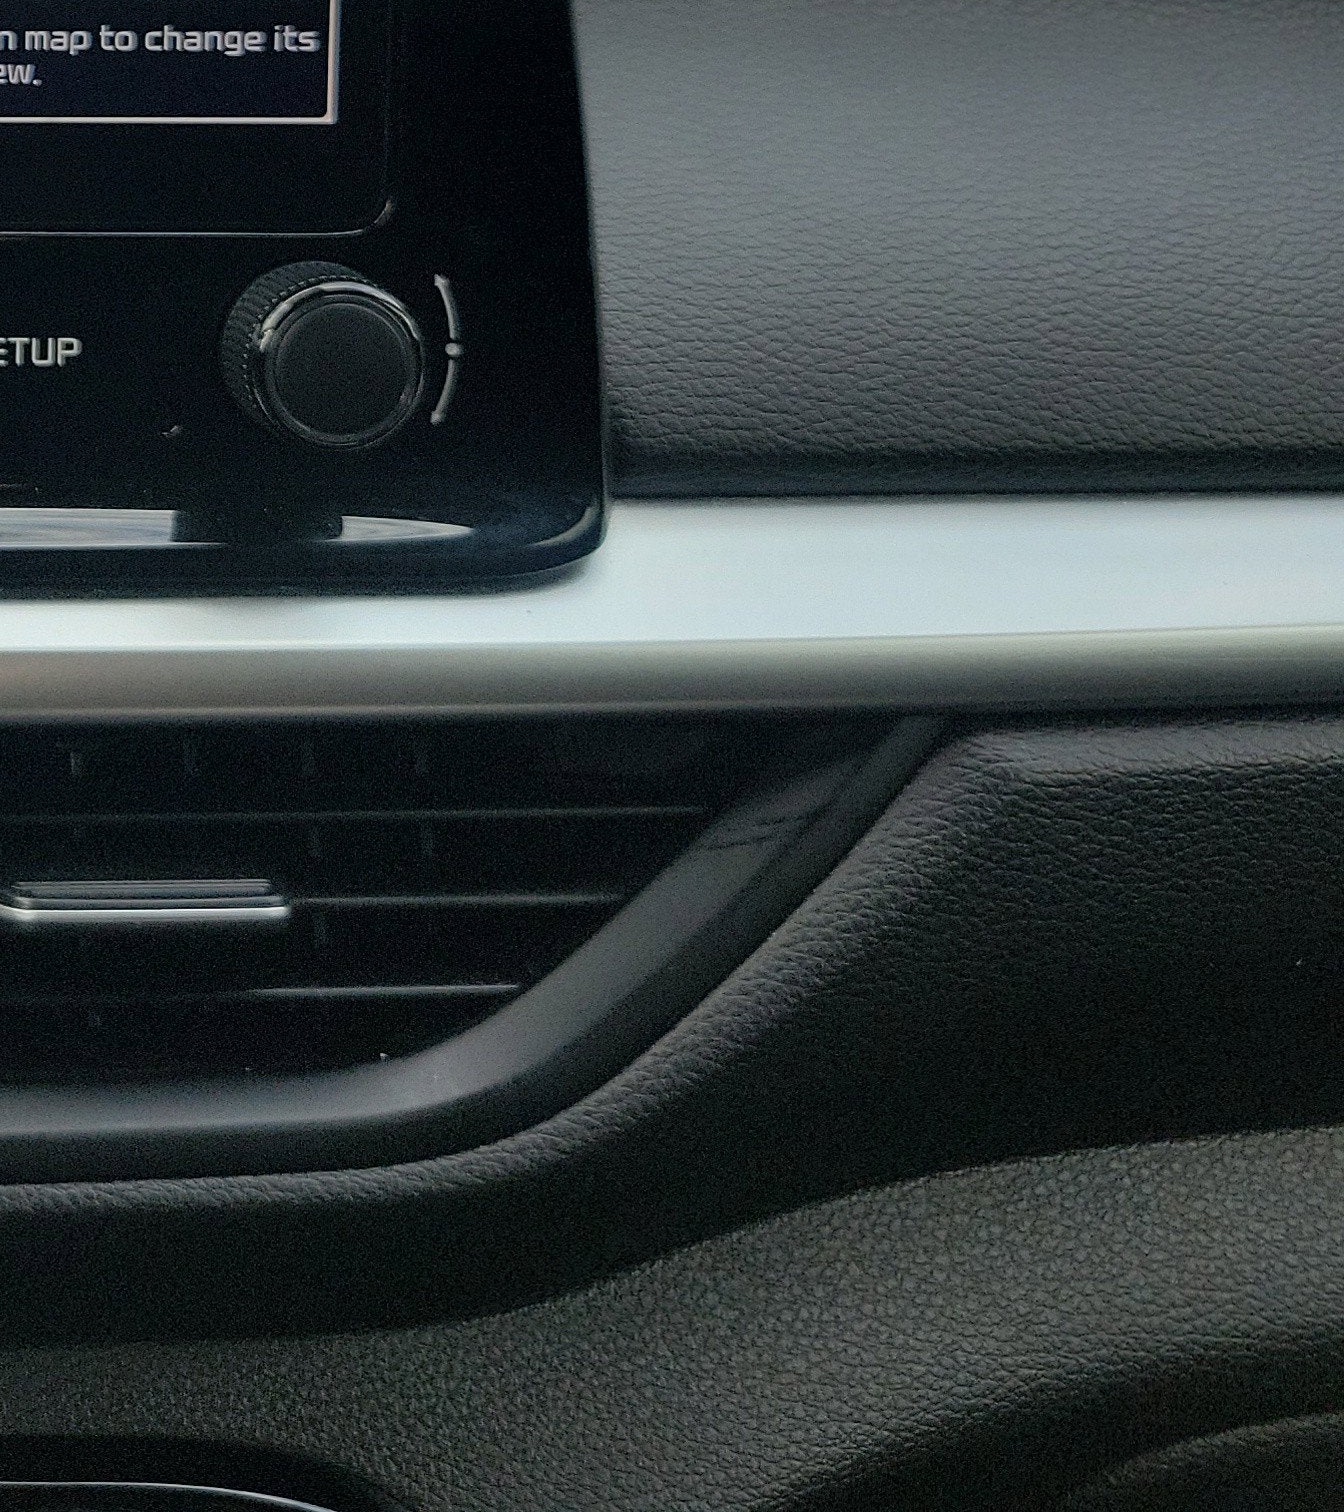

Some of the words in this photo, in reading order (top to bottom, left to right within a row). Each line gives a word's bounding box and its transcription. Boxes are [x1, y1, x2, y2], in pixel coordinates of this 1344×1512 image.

[25, 30, 92, 56] map
[99, 24, 138, 52] to
[144, 24, 267, 57] change
[273, 25, 321, 52] its
